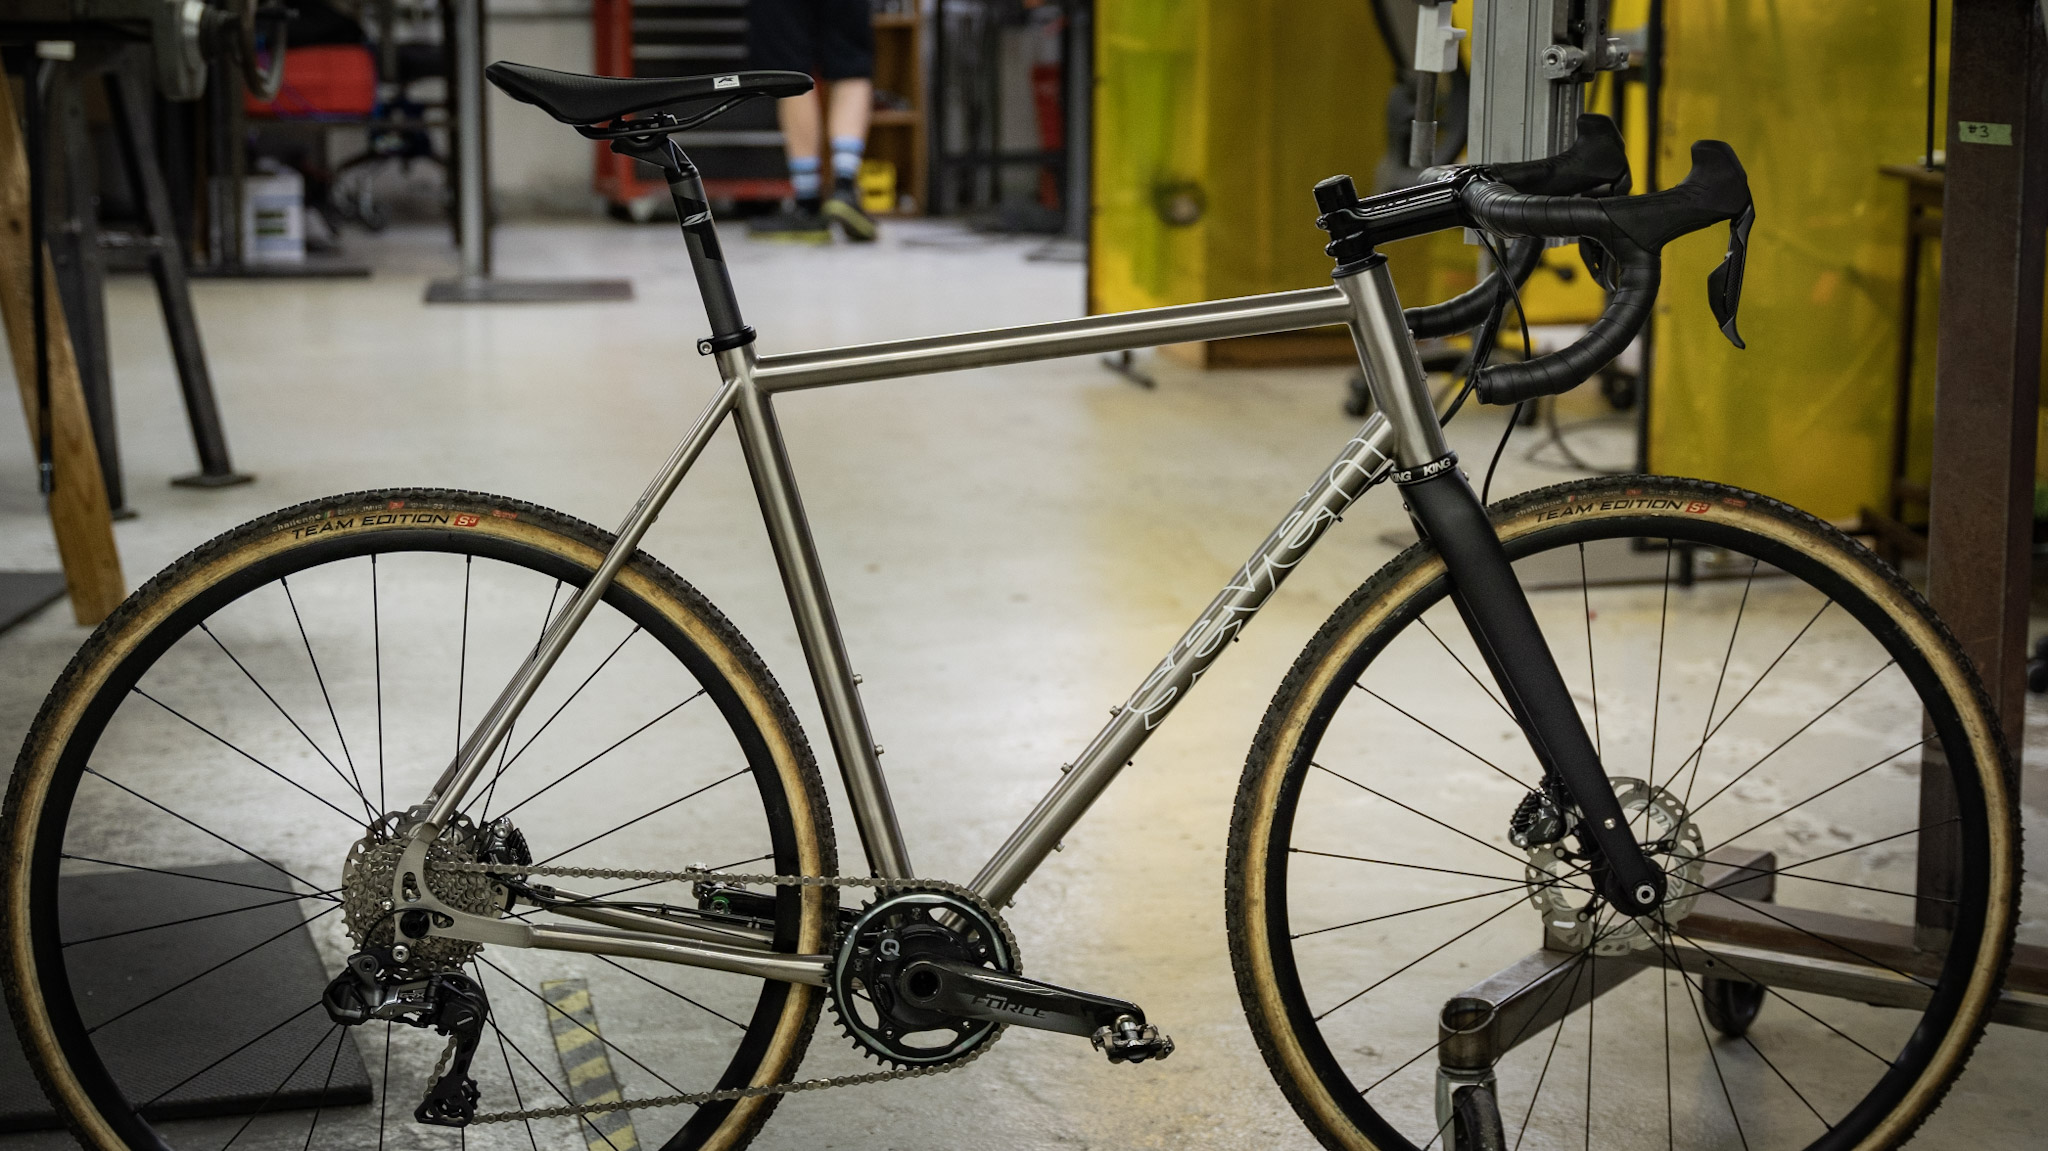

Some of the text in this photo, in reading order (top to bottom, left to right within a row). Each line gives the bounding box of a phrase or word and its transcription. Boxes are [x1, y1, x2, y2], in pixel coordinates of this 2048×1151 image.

[1967, 124, 1990, 138] #3
[1423, 457, 1451, 477] KING
[1535, 503, 1593, 522] TEAM
[1600, 499, 1683, 511] EDITION
[272, 513, 322, 532] challenge
[292, 517, 354, 539] TEAM
[362, 513, 450, 526] EDITION
[880, 938, 901, 957] Q
[970, 996, 1048, 1019] FORCE
